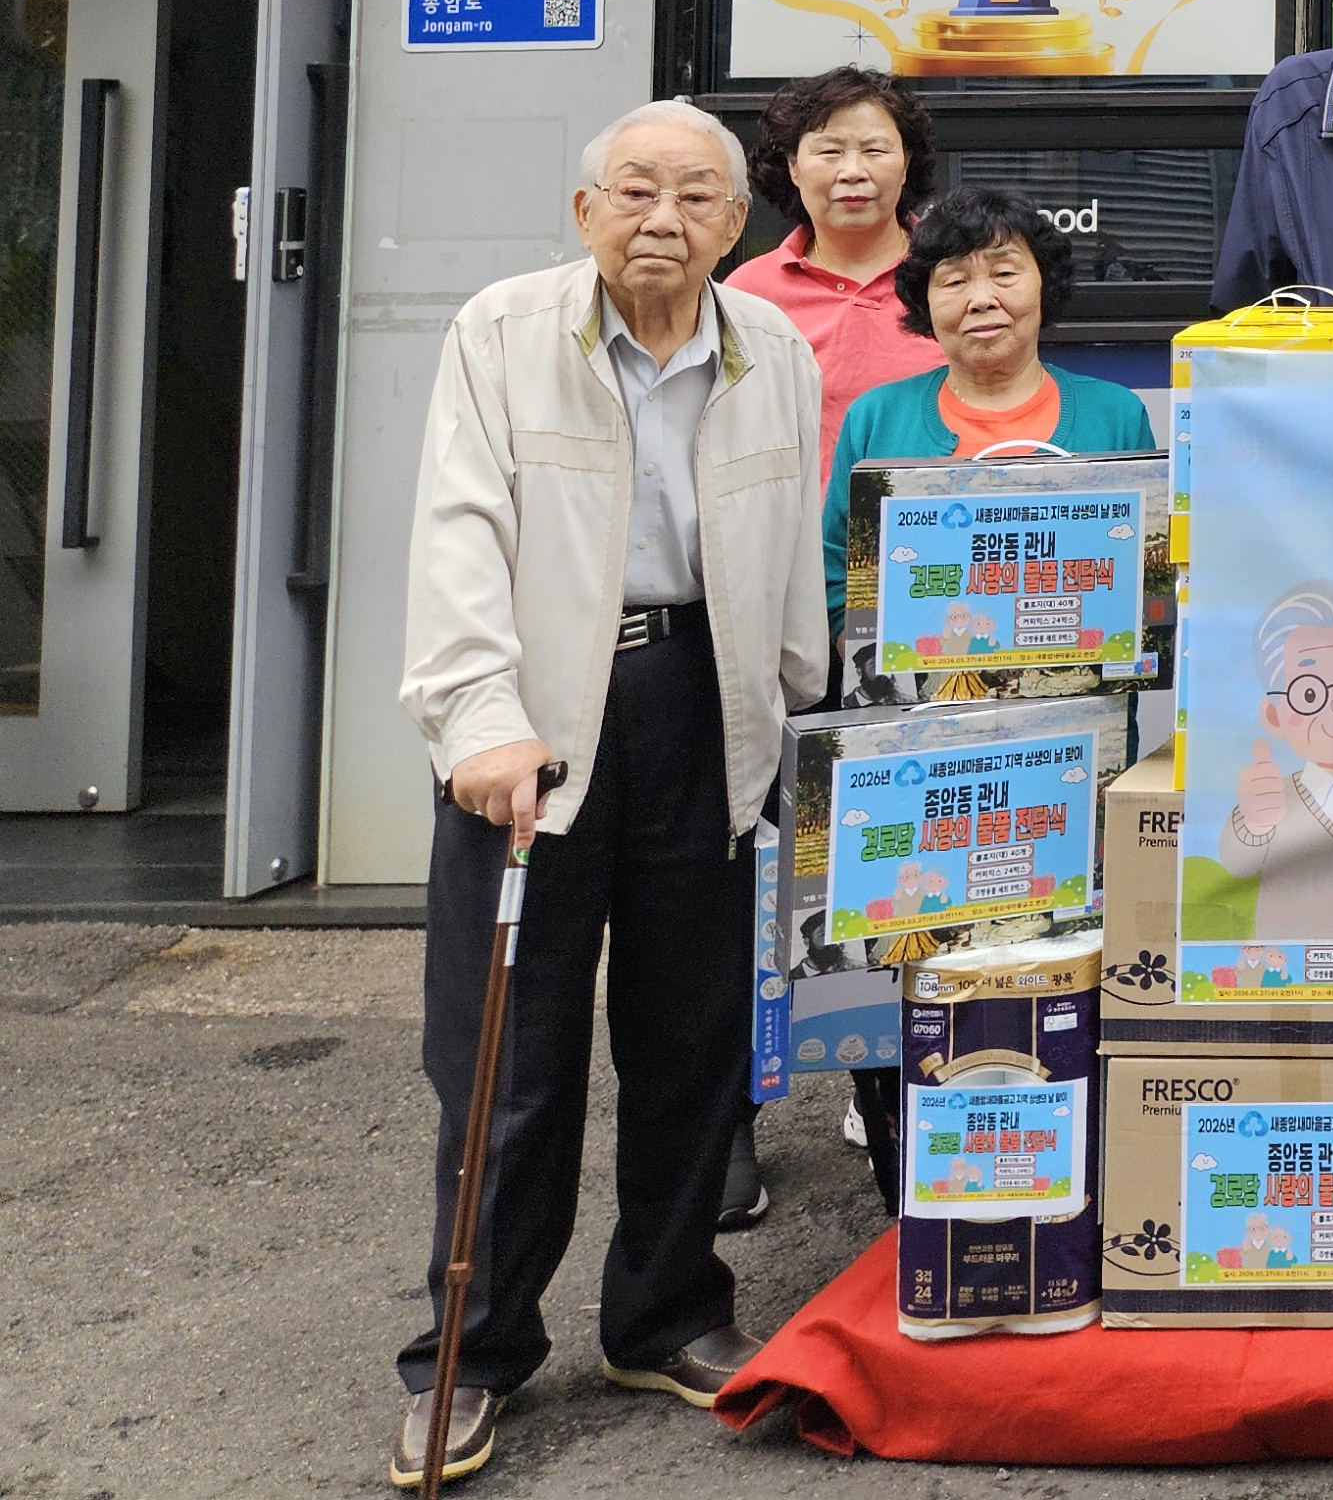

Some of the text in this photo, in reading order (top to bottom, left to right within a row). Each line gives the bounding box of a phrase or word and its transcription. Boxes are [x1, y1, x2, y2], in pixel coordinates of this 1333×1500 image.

[422, 20, 493, 35] Jongam-ro
[970, 531, 1056, 562] 종암동 관내
[908, 557, 1115, 598] 경로당 사랑의 물품 전달식
[1142, 1104, 1182, 1117] Premiu
